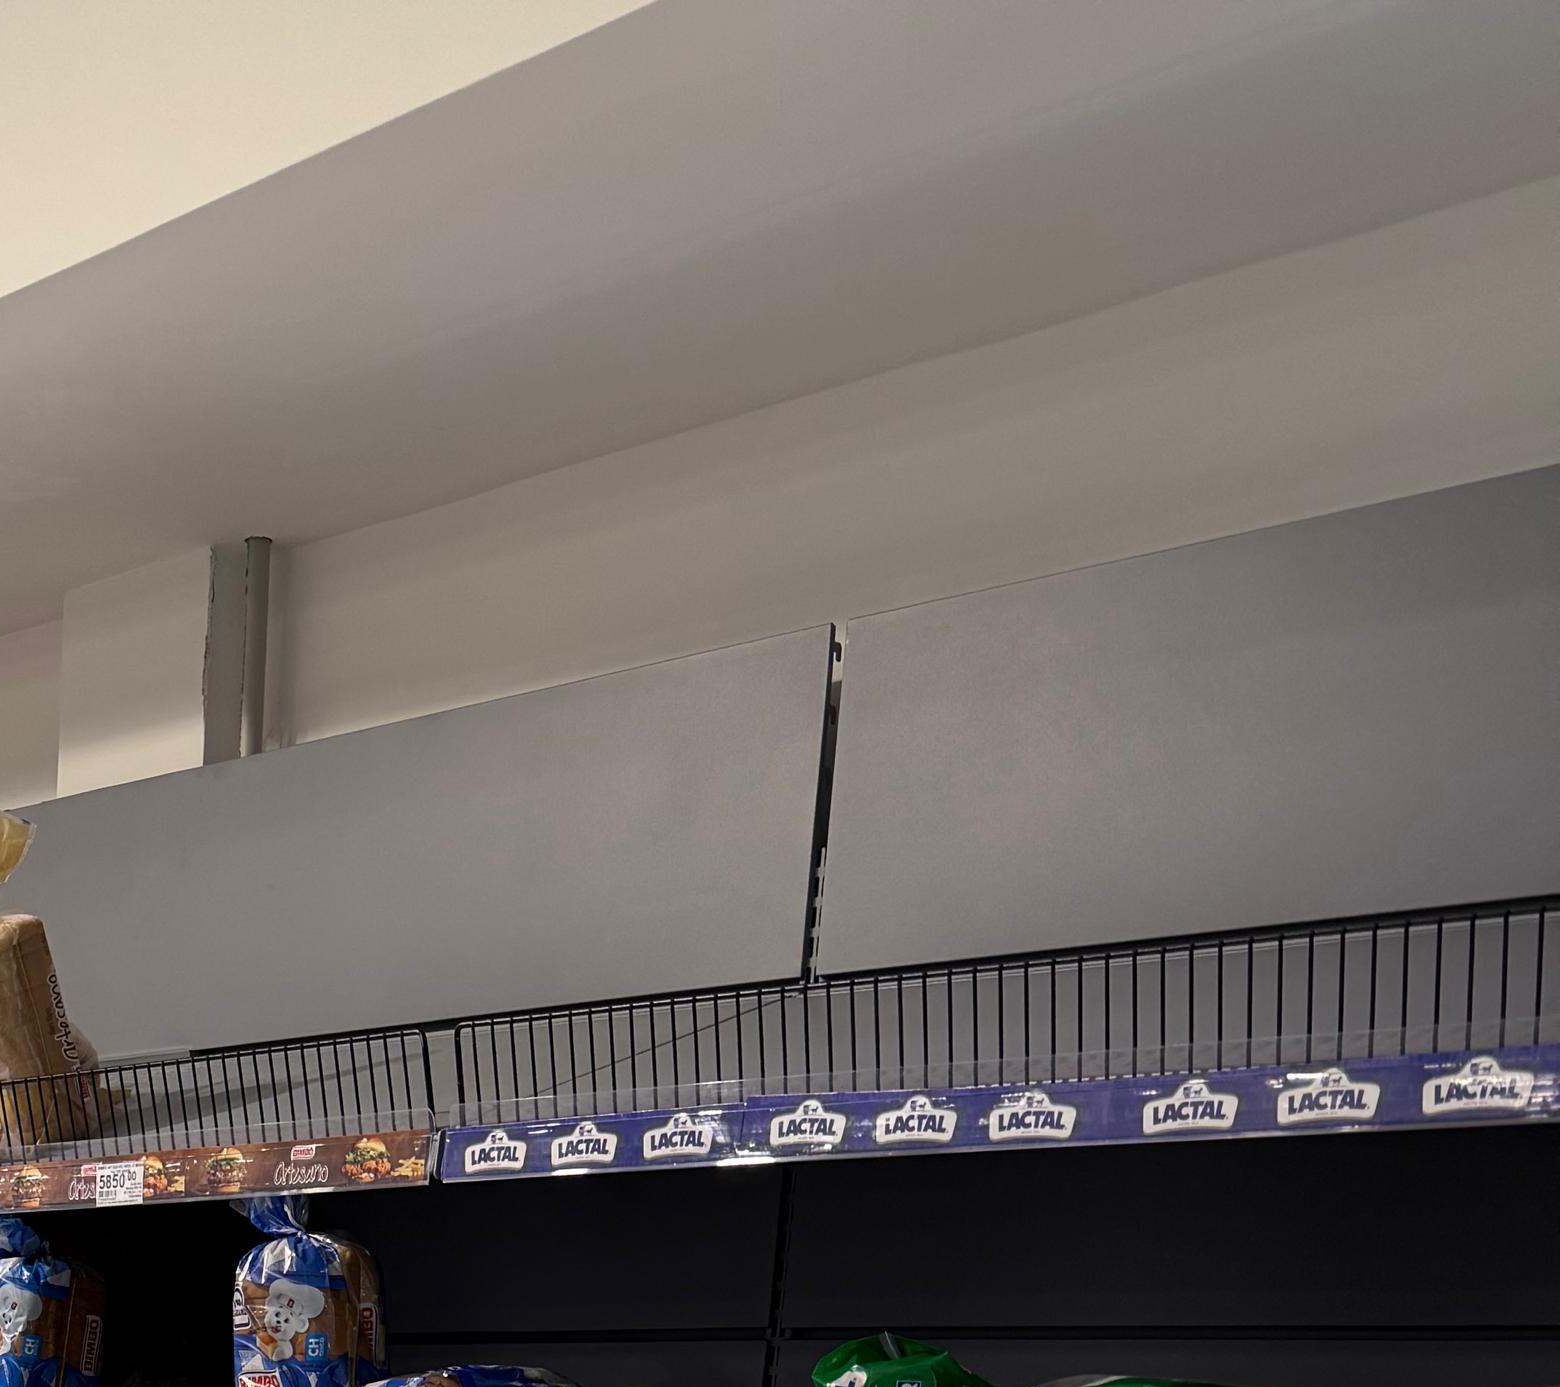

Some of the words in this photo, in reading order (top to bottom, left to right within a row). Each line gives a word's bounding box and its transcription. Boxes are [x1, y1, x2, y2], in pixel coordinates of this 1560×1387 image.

[1288, 1089, 1369, 1114] LACTAL
[998, 1110, 1067, 1132] LACTAL
[1153, 1100, 1228, 1125] LACTAL
[778, 1117, 837, 1137] LACTAL
[884, 1114, 947, 1135] LACTAL
[557, 1138, 609, 1158] LACTAL
[650, 1129, 705, 1151] LACTAL
[470, 1146, 520, 1164] LACTAL
